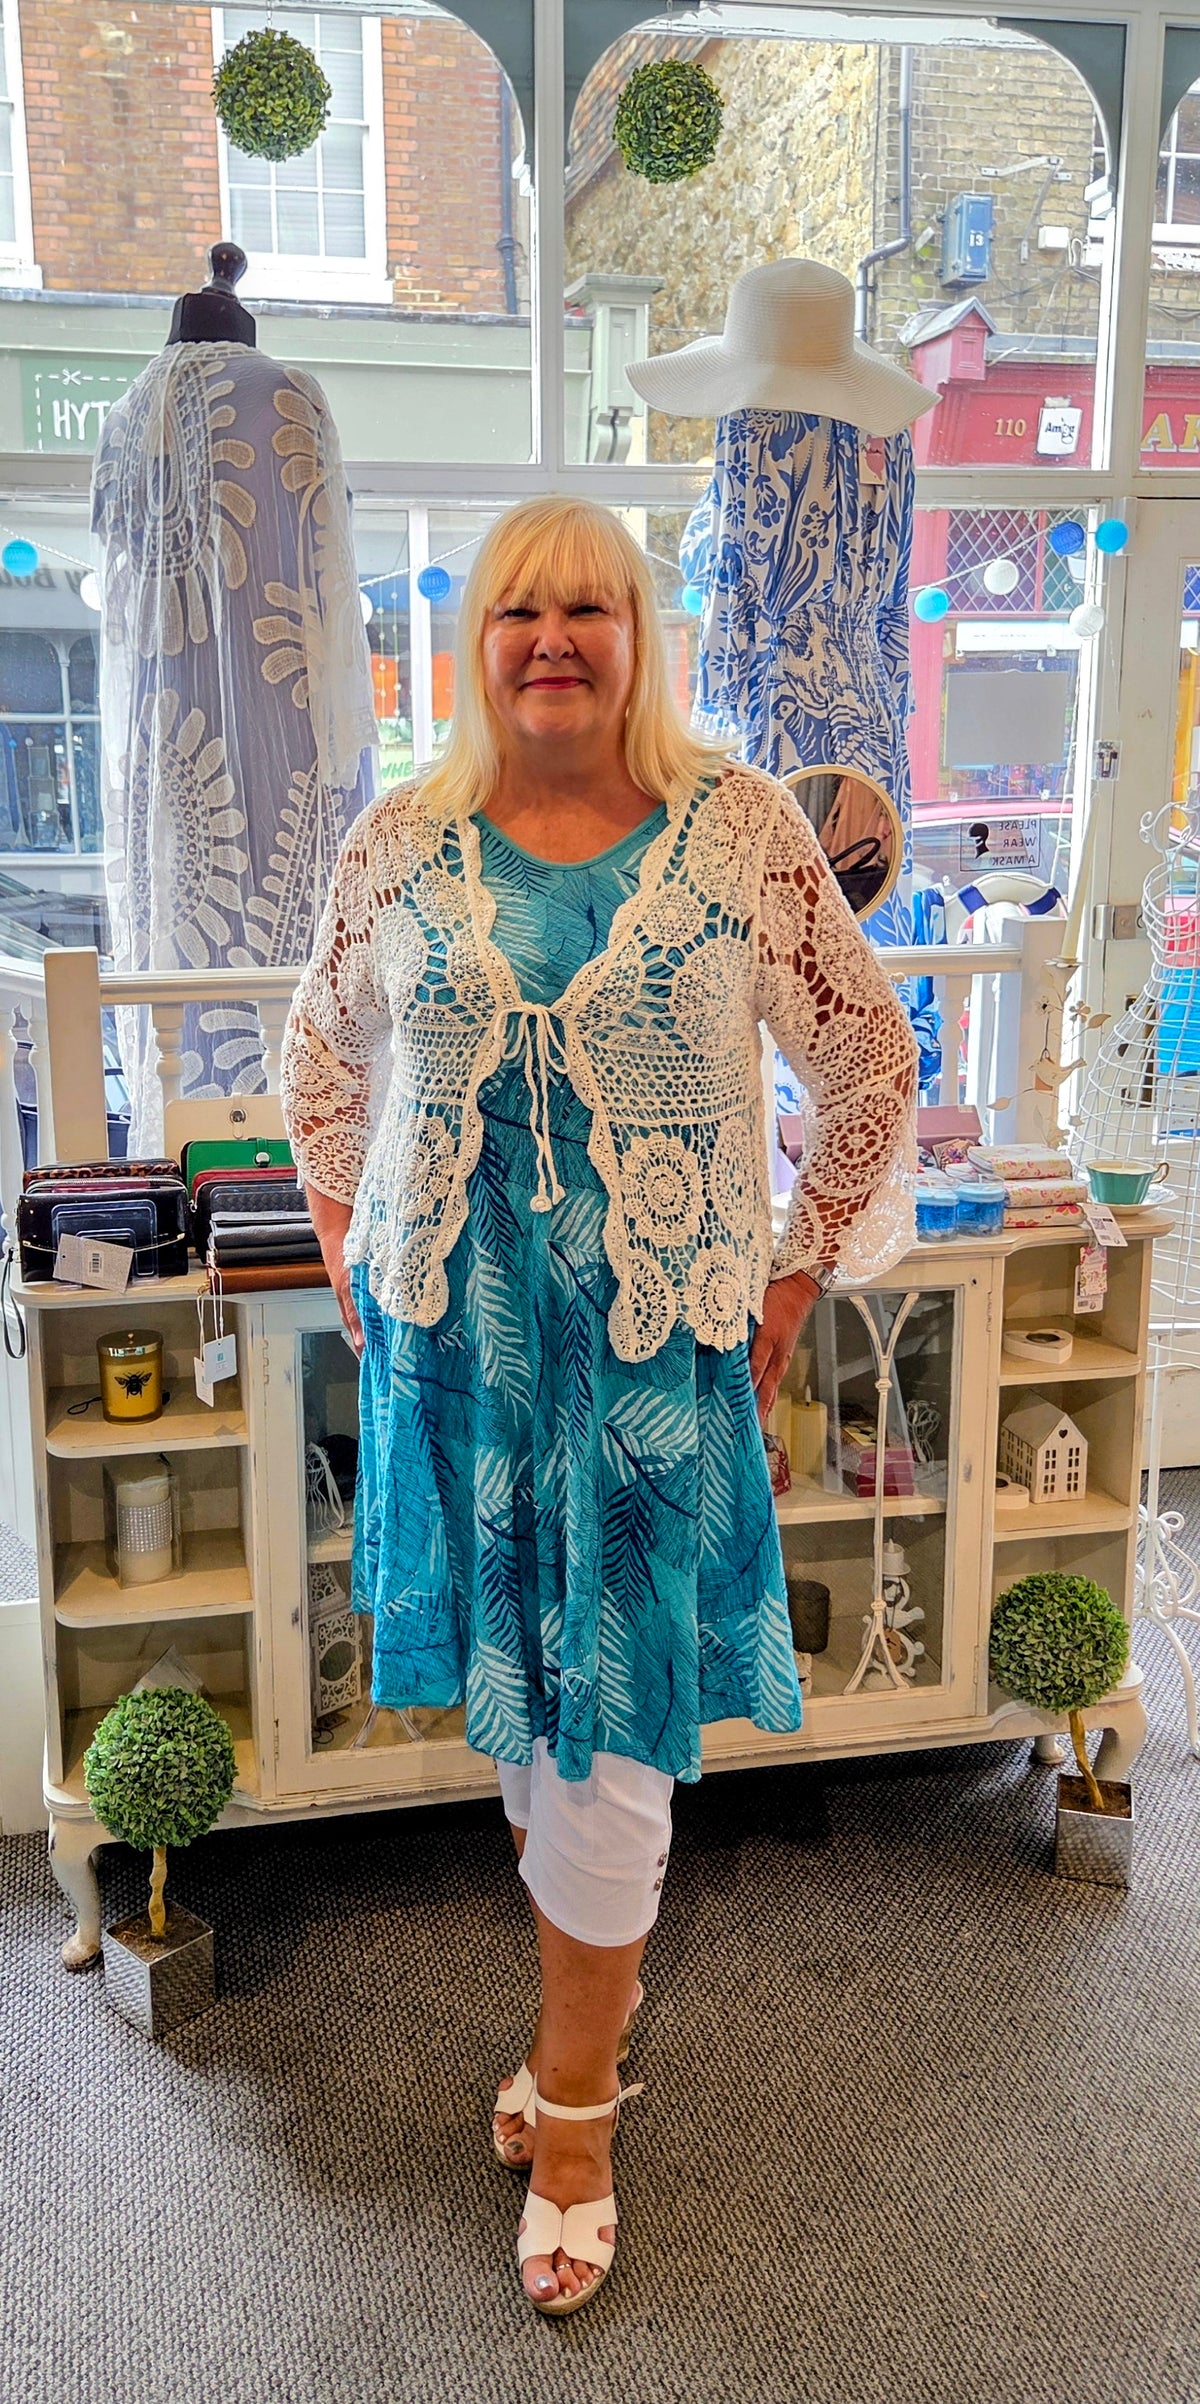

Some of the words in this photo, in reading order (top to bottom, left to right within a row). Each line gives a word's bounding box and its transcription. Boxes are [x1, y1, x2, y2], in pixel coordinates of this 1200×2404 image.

[969, 229, 984, 247] 13
[52, 399, 111, 440] HYT
[994, 418, 1027, 437] 110
